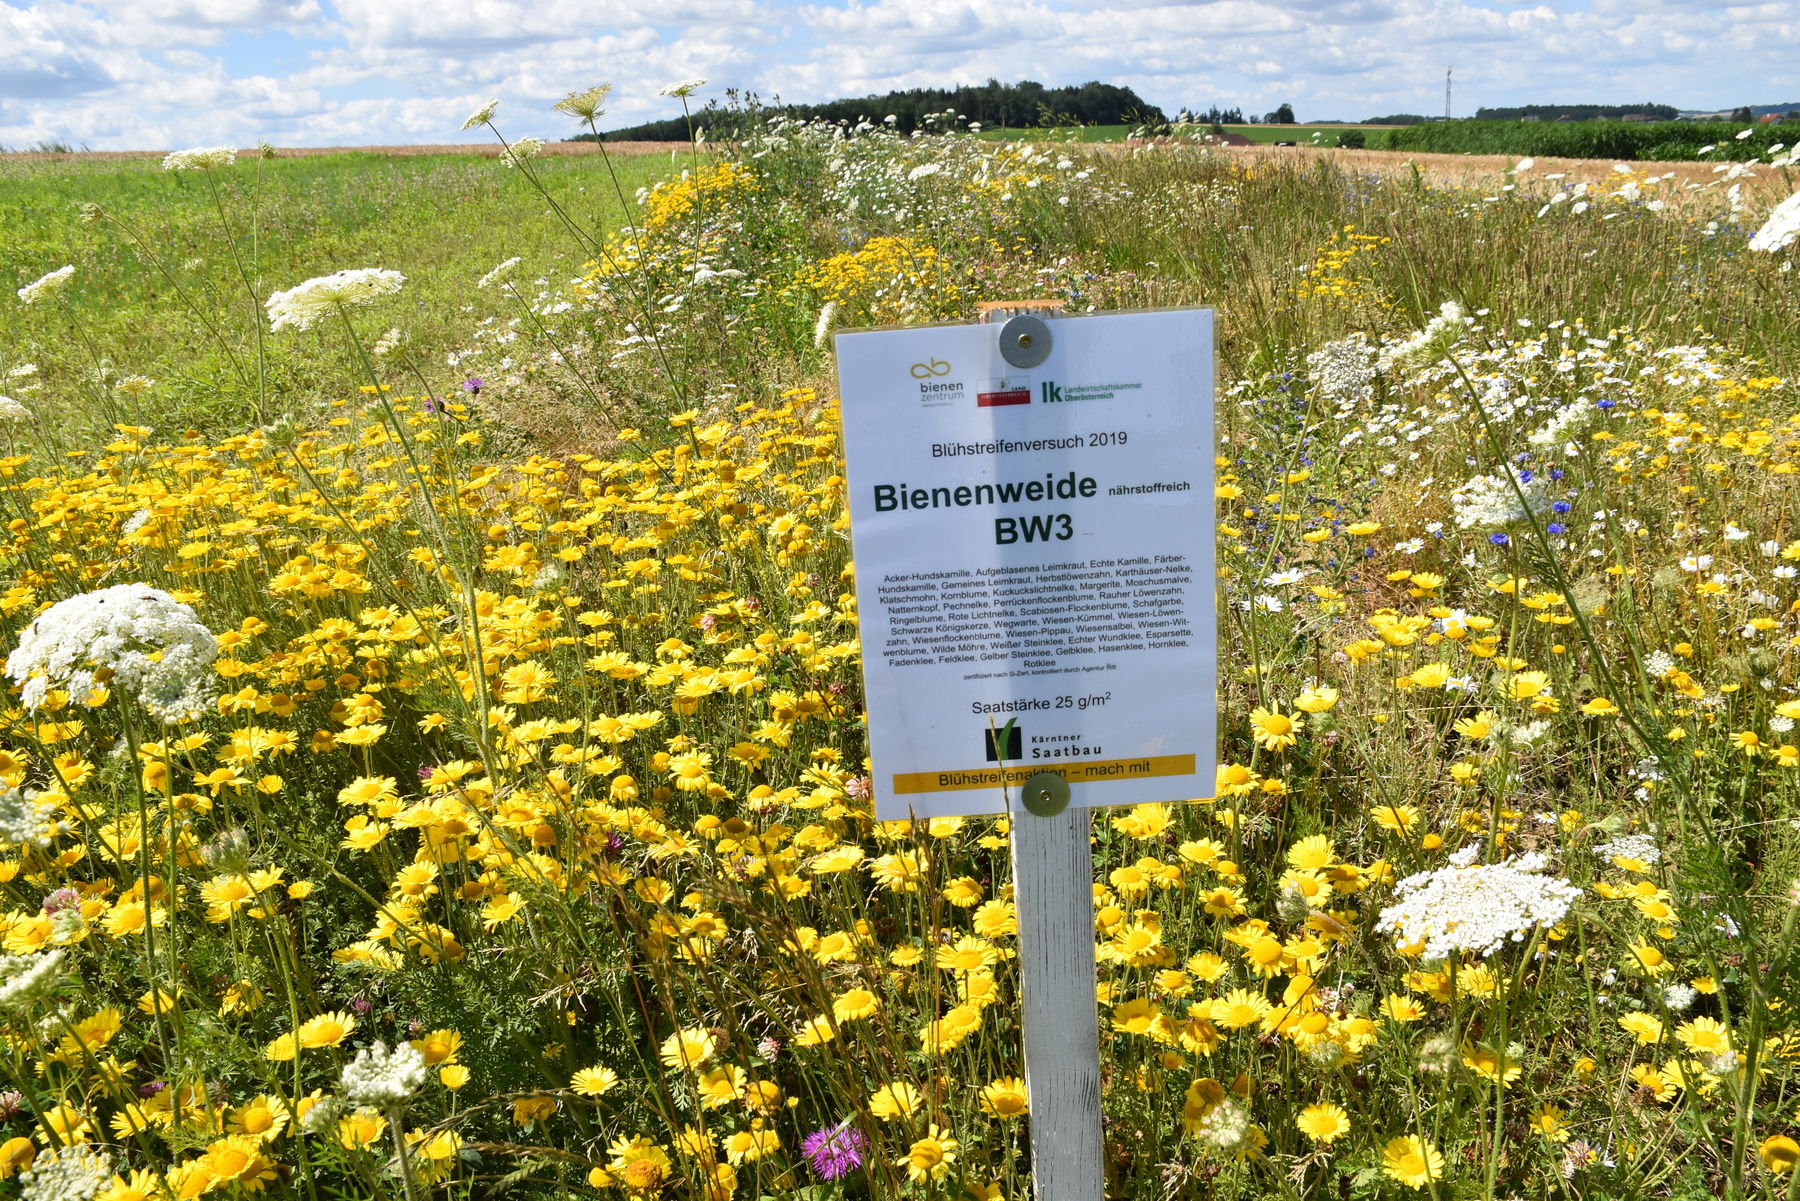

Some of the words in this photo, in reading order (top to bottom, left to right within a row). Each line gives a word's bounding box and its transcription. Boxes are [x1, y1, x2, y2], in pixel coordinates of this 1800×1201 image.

[921, 382, 963, 392] bienen
[921, 392, 964, 402] zentrum
[1065, 382, 1142, 394] Landwirtschaftskammer
[1065, 392, 1114, 402] Oberösterreich
[932, 435, 1083, 457] Blühstreifenversuch
[1089, 431, 1128, 446] 2019
[874, 471, 1097, 512] Bienenweide
[1109, 481, 1190, 496] nährstoffreich
[995, 514, 1074, 545] BW3
[878, 584, 938, 594] Hundskamille,
[942, 581, 985, 590] Gemeines
[988, 574, 1033, 586] Leimkraut,
[1036, 572, 1113, 582] Herbstlöwenzahn,
[1116, 565, 1192, 576] Karthäuser-Nelke,
[884, 571, 972, 582] Acker-Hundskamille,
[976, 565, 1039, 577] Aufgeblasenes
[1043, 562, 1087, 572] Leimkraut,
[1118, 557, 1151, 565] Kamille,
[1155, 555, 1186, 563] Färber-
[880, 595, 938, 604] Klatschmohn,
[941, 592, 990, 600] Kornblume,
[993, 585, 1077, 596] Kuckuckslichtnelke,
[1080, 582, 1122, 591] Margerite,
[1126, 577, 1192, 587] Moschusmalve,
[888, 605, 940, 615] Natternkopf,
[944, 602, 991, 610] Pechnelke,
[994, 593, 1096, 606] Perrückenflockenblume,
[1134, 588, 1184, 597] Löwenzahn,
[890, 615, 946, 626] Ringelblume,
[949, 613, 968, 621] Rote
[972, 611, 1017, 620] Lichtnelke,
[1020, 603, 1130, 616] Scabiosen-Flockenblume,
[1133, 600, 1184, 609] Schafgarbe,
[891, 626, 933, 635] Schwarze
[936, 623, 991, 633] Königskerze,
[994, 620, 1039, 629] Wegwarte,
[1043, 614, 1114, 624] Wiesen-Kümmel,
[1118, 609, 1184, 619] Wiesen-Löwen-
[883, 648, 928, 656] wenblume,
[932, 645, 955, 653] Wilde
[959, 643, 987, 652] Möhre,
[990, 641, 1021, 649] Weißer
[1024, 638, 1065, 647] Steinklee,
[1069, 636, 1095, 644] Echter
[1098, 633, 1143, 642] Wundklee,
[1146, 629, 1194, 640] Esparsette,
[887, 638, 910, 646] zahn,
[912, 632, 1003, 644] Wiesenflockenblume,
[1006, 627, 1073, 638] Wiesen-Pippau,
[1076, 624, 1135, 633] Wiesensalbei,
[1138, 620, 1189, 629] Wiesen-Wit-
[889, 658, 936, 667] Fadenklee,
[939, 655, 977, 663] Feldklee,
[980, 652, 1008, 660] Gelber
[1012, 649, 1052, 658] Steinklee,
[1056, 646, 1095, 655] Gelbklee,
[1099, 643, 1145, 652] Hasenklee,
[1149, 640, 1188, 649] Hornklee,
[1024, 660, 1056, 668] Rotklee
[972, 698, 1050, 714] Saatstärke
[1055, 696, 1073, 709] 25
[1032, 733, 1081, 743] Kärntner
[1032, 745, 1102, 758] Saatbau
[1085, 764, 1123, 775] mach
[1128, 761, 1150, 773] mit
